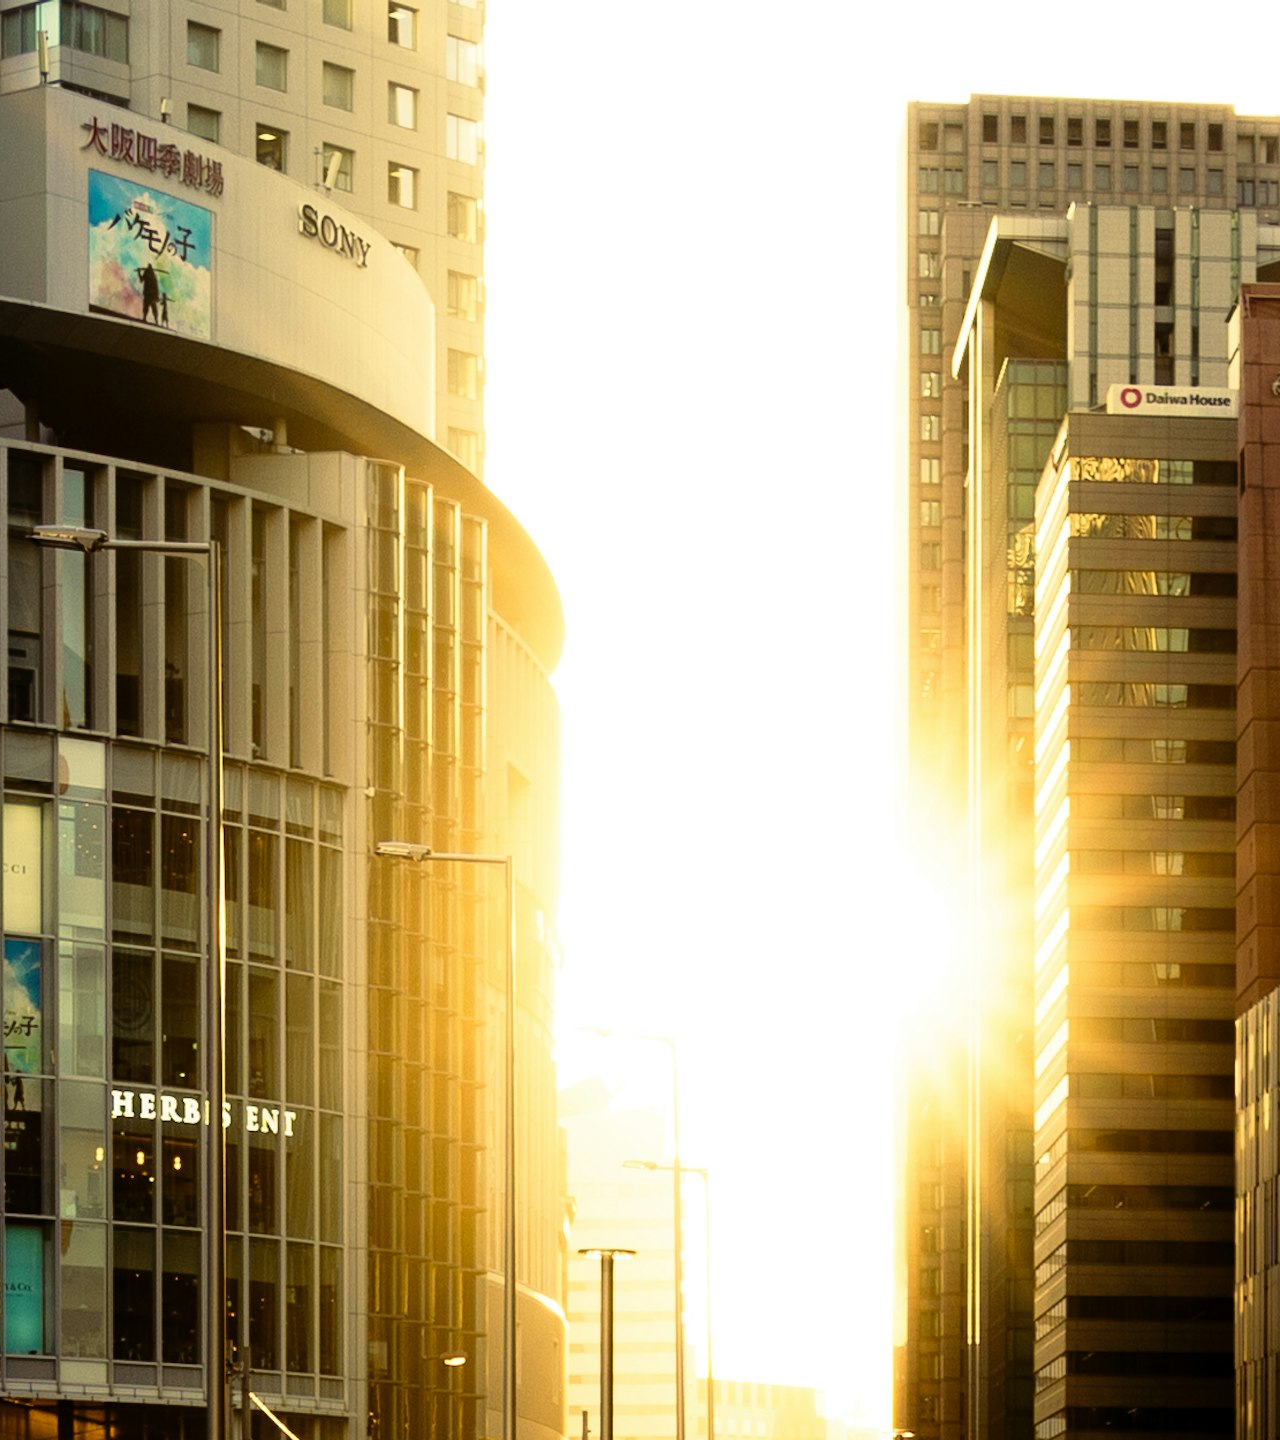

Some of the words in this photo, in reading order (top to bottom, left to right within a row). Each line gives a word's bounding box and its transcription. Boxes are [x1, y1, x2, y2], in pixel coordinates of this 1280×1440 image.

[81, 116, 224, 196] 大阪四季劇場
[108, 209, 196, 261] バケモノの子
[299, 203, 371, 268] SONY
[1146, 392, 1187, 405] Daiwa
[1189, 394, 1231, 407] House
[246, 1105, 297, 1137] ENT
